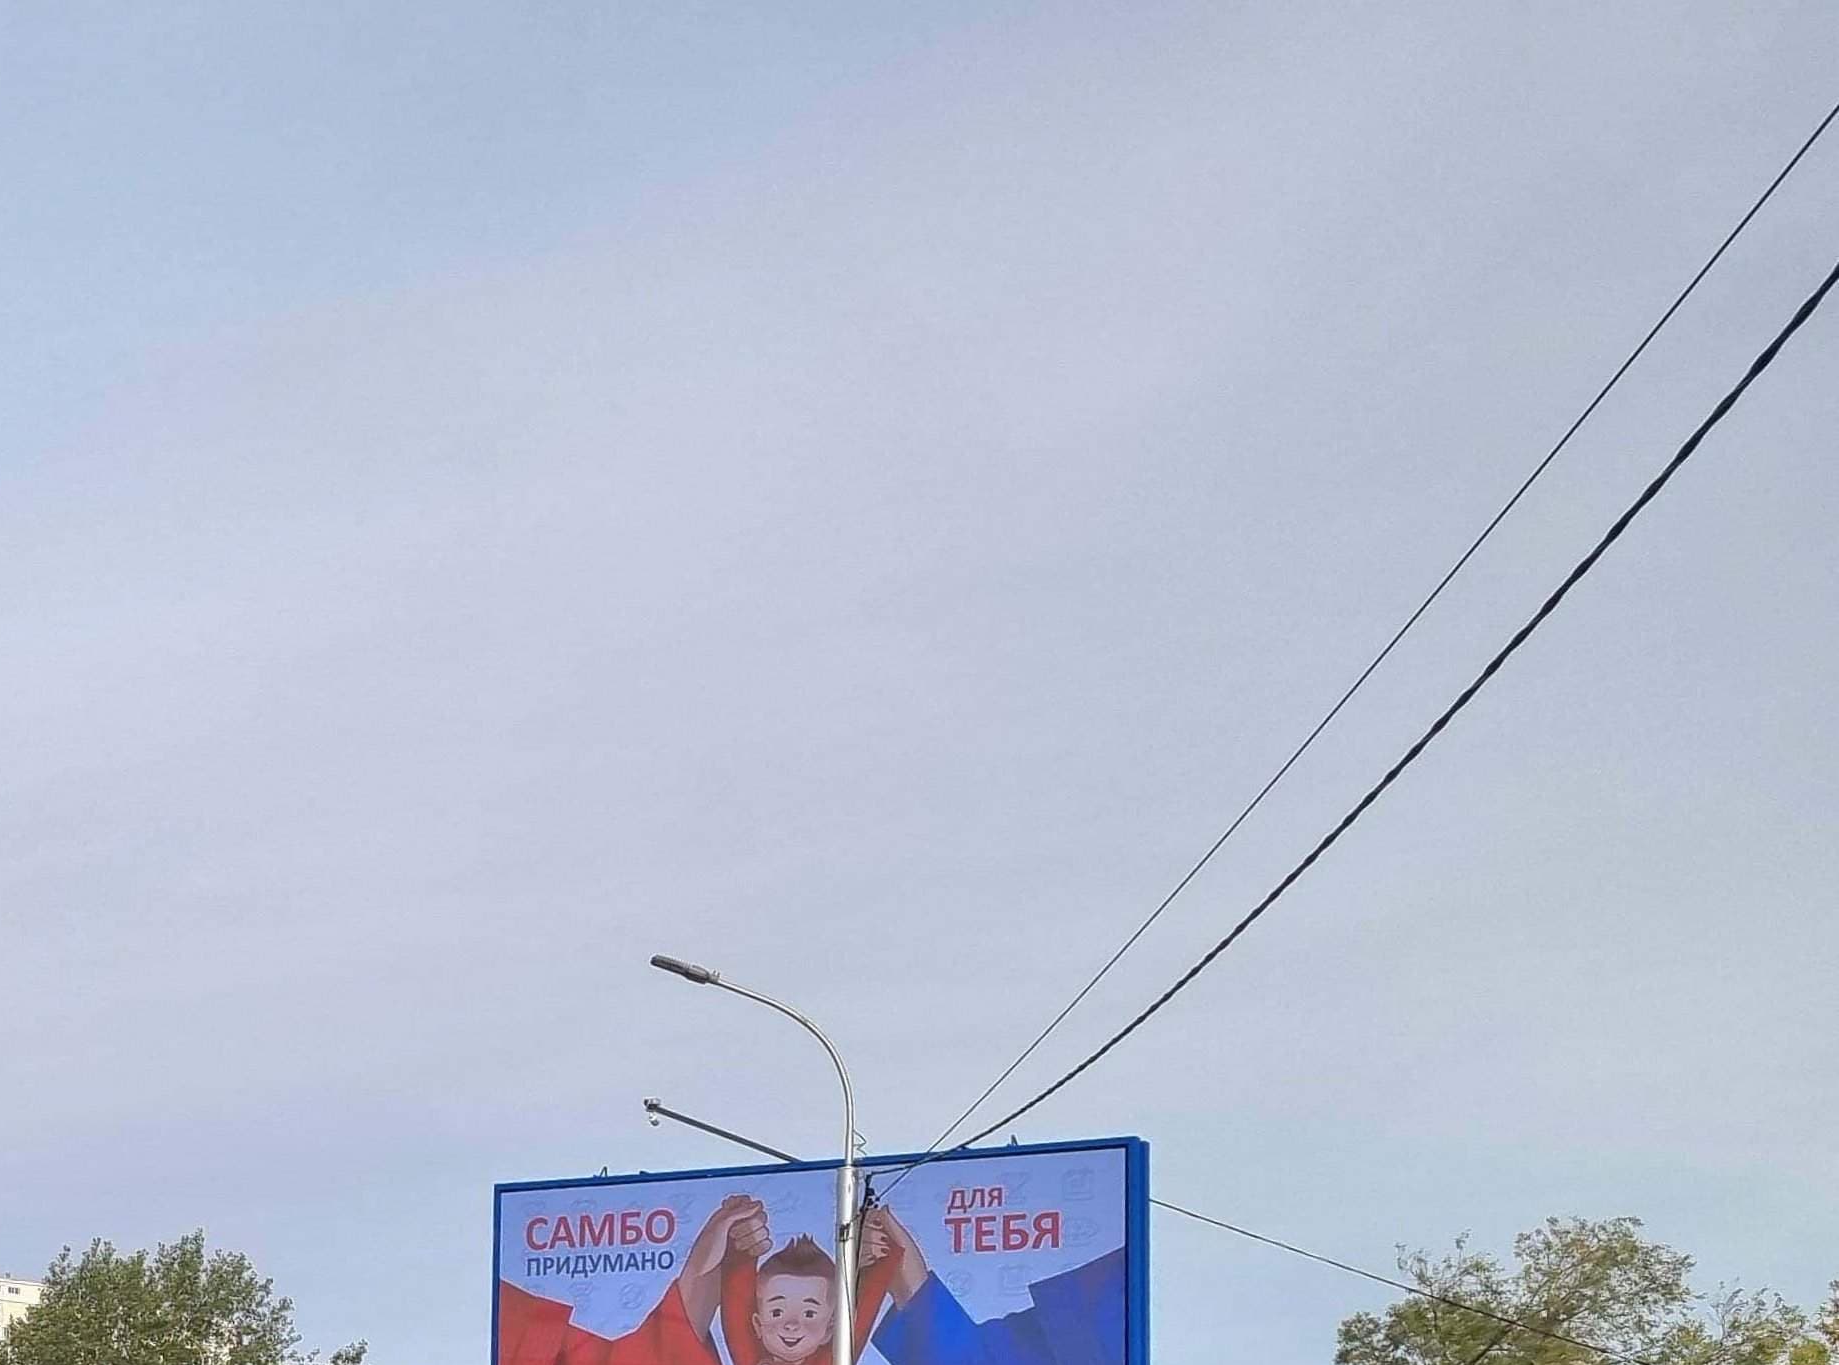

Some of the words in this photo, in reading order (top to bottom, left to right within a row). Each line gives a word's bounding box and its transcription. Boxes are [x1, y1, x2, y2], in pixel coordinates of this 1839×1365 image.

[947, 1187, 1003, 1215] ДЛЯ
[526, 1209, 676, 1251] САМБО
[944, 1211, 1060, 1253] ТЕБЯ
[526, 1251, 675, 1278] ПРИДУМАНО
